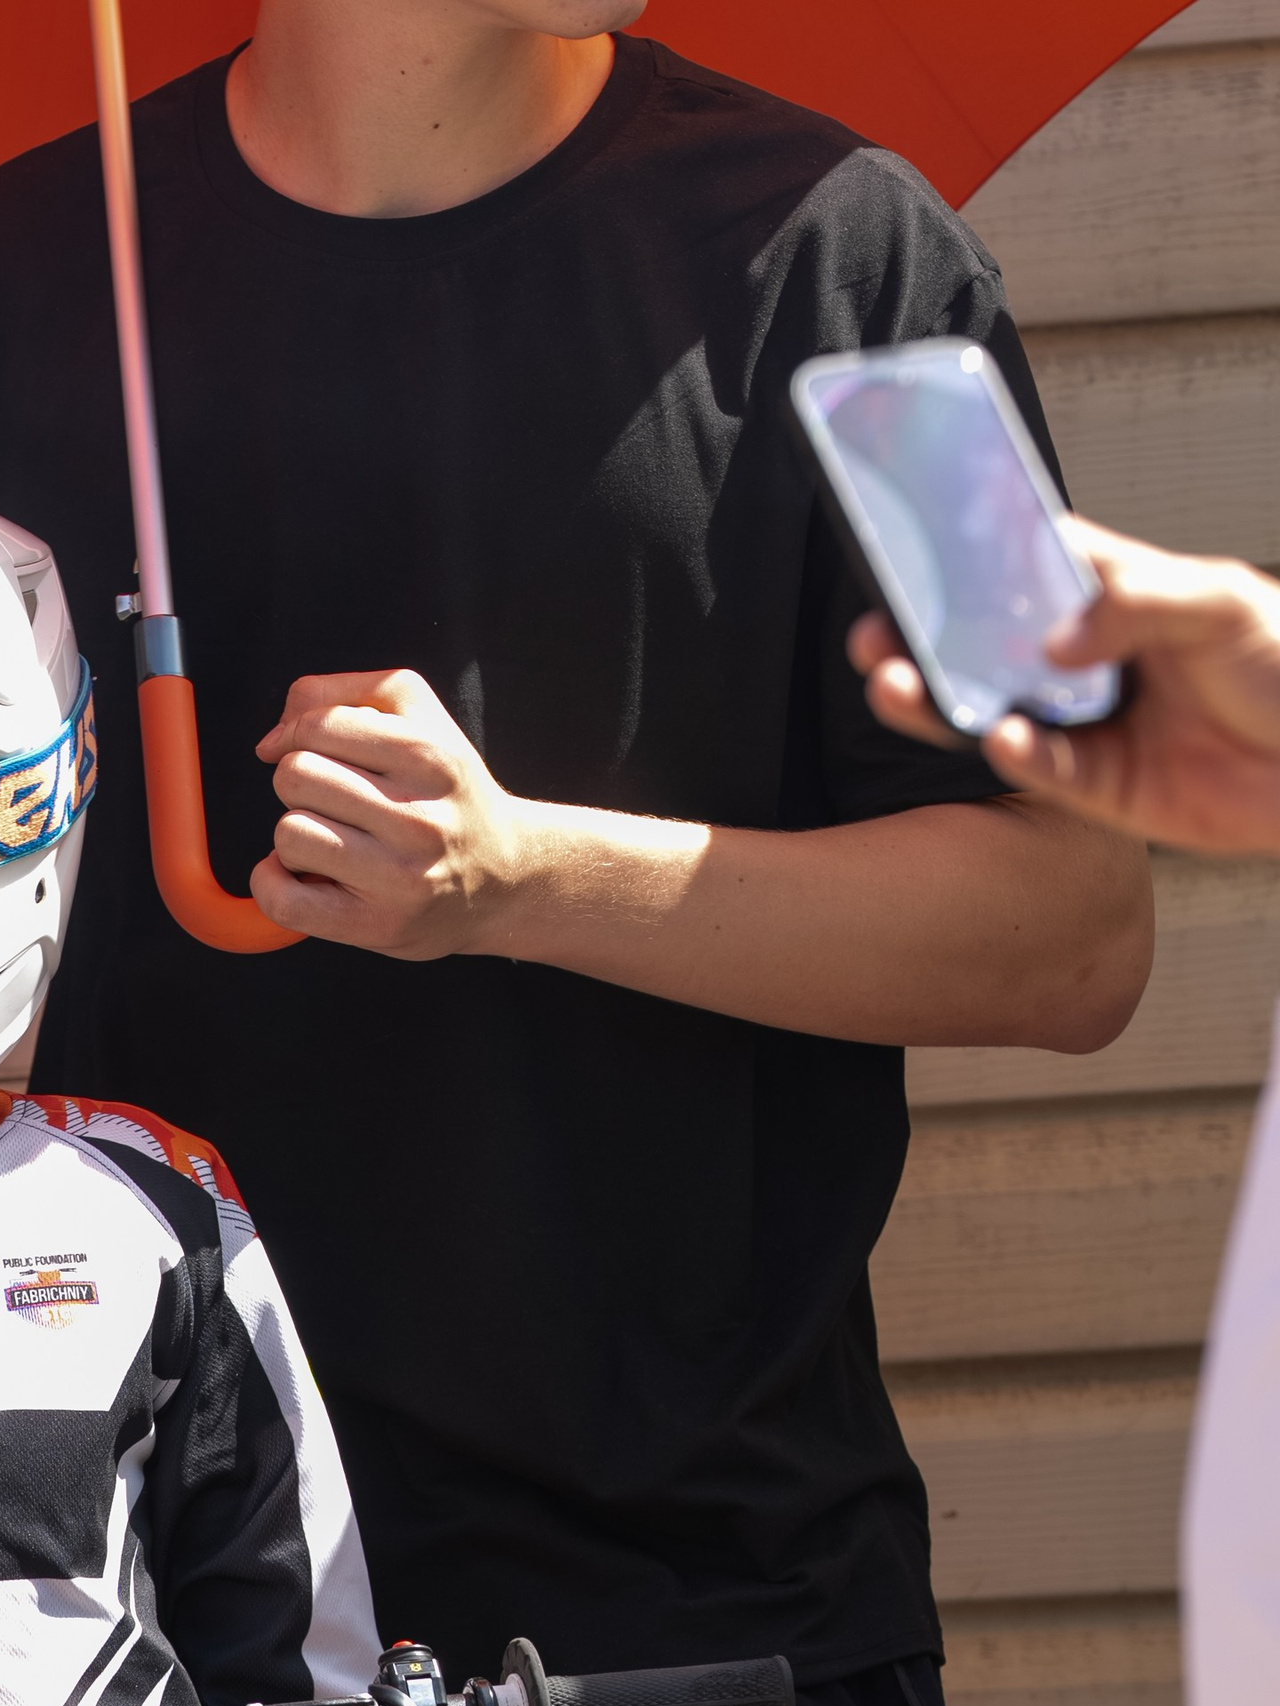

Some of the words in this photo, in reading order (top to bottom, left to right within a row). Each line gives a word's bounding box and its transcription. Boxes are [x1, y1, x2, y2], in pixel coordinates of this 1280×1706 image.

[2, 1256, 33, 1269] PUBLIC
[35, 1253, 87, 1266] FOUNDATION
[14, 1285, 88, 1306] FABRICHNIY
